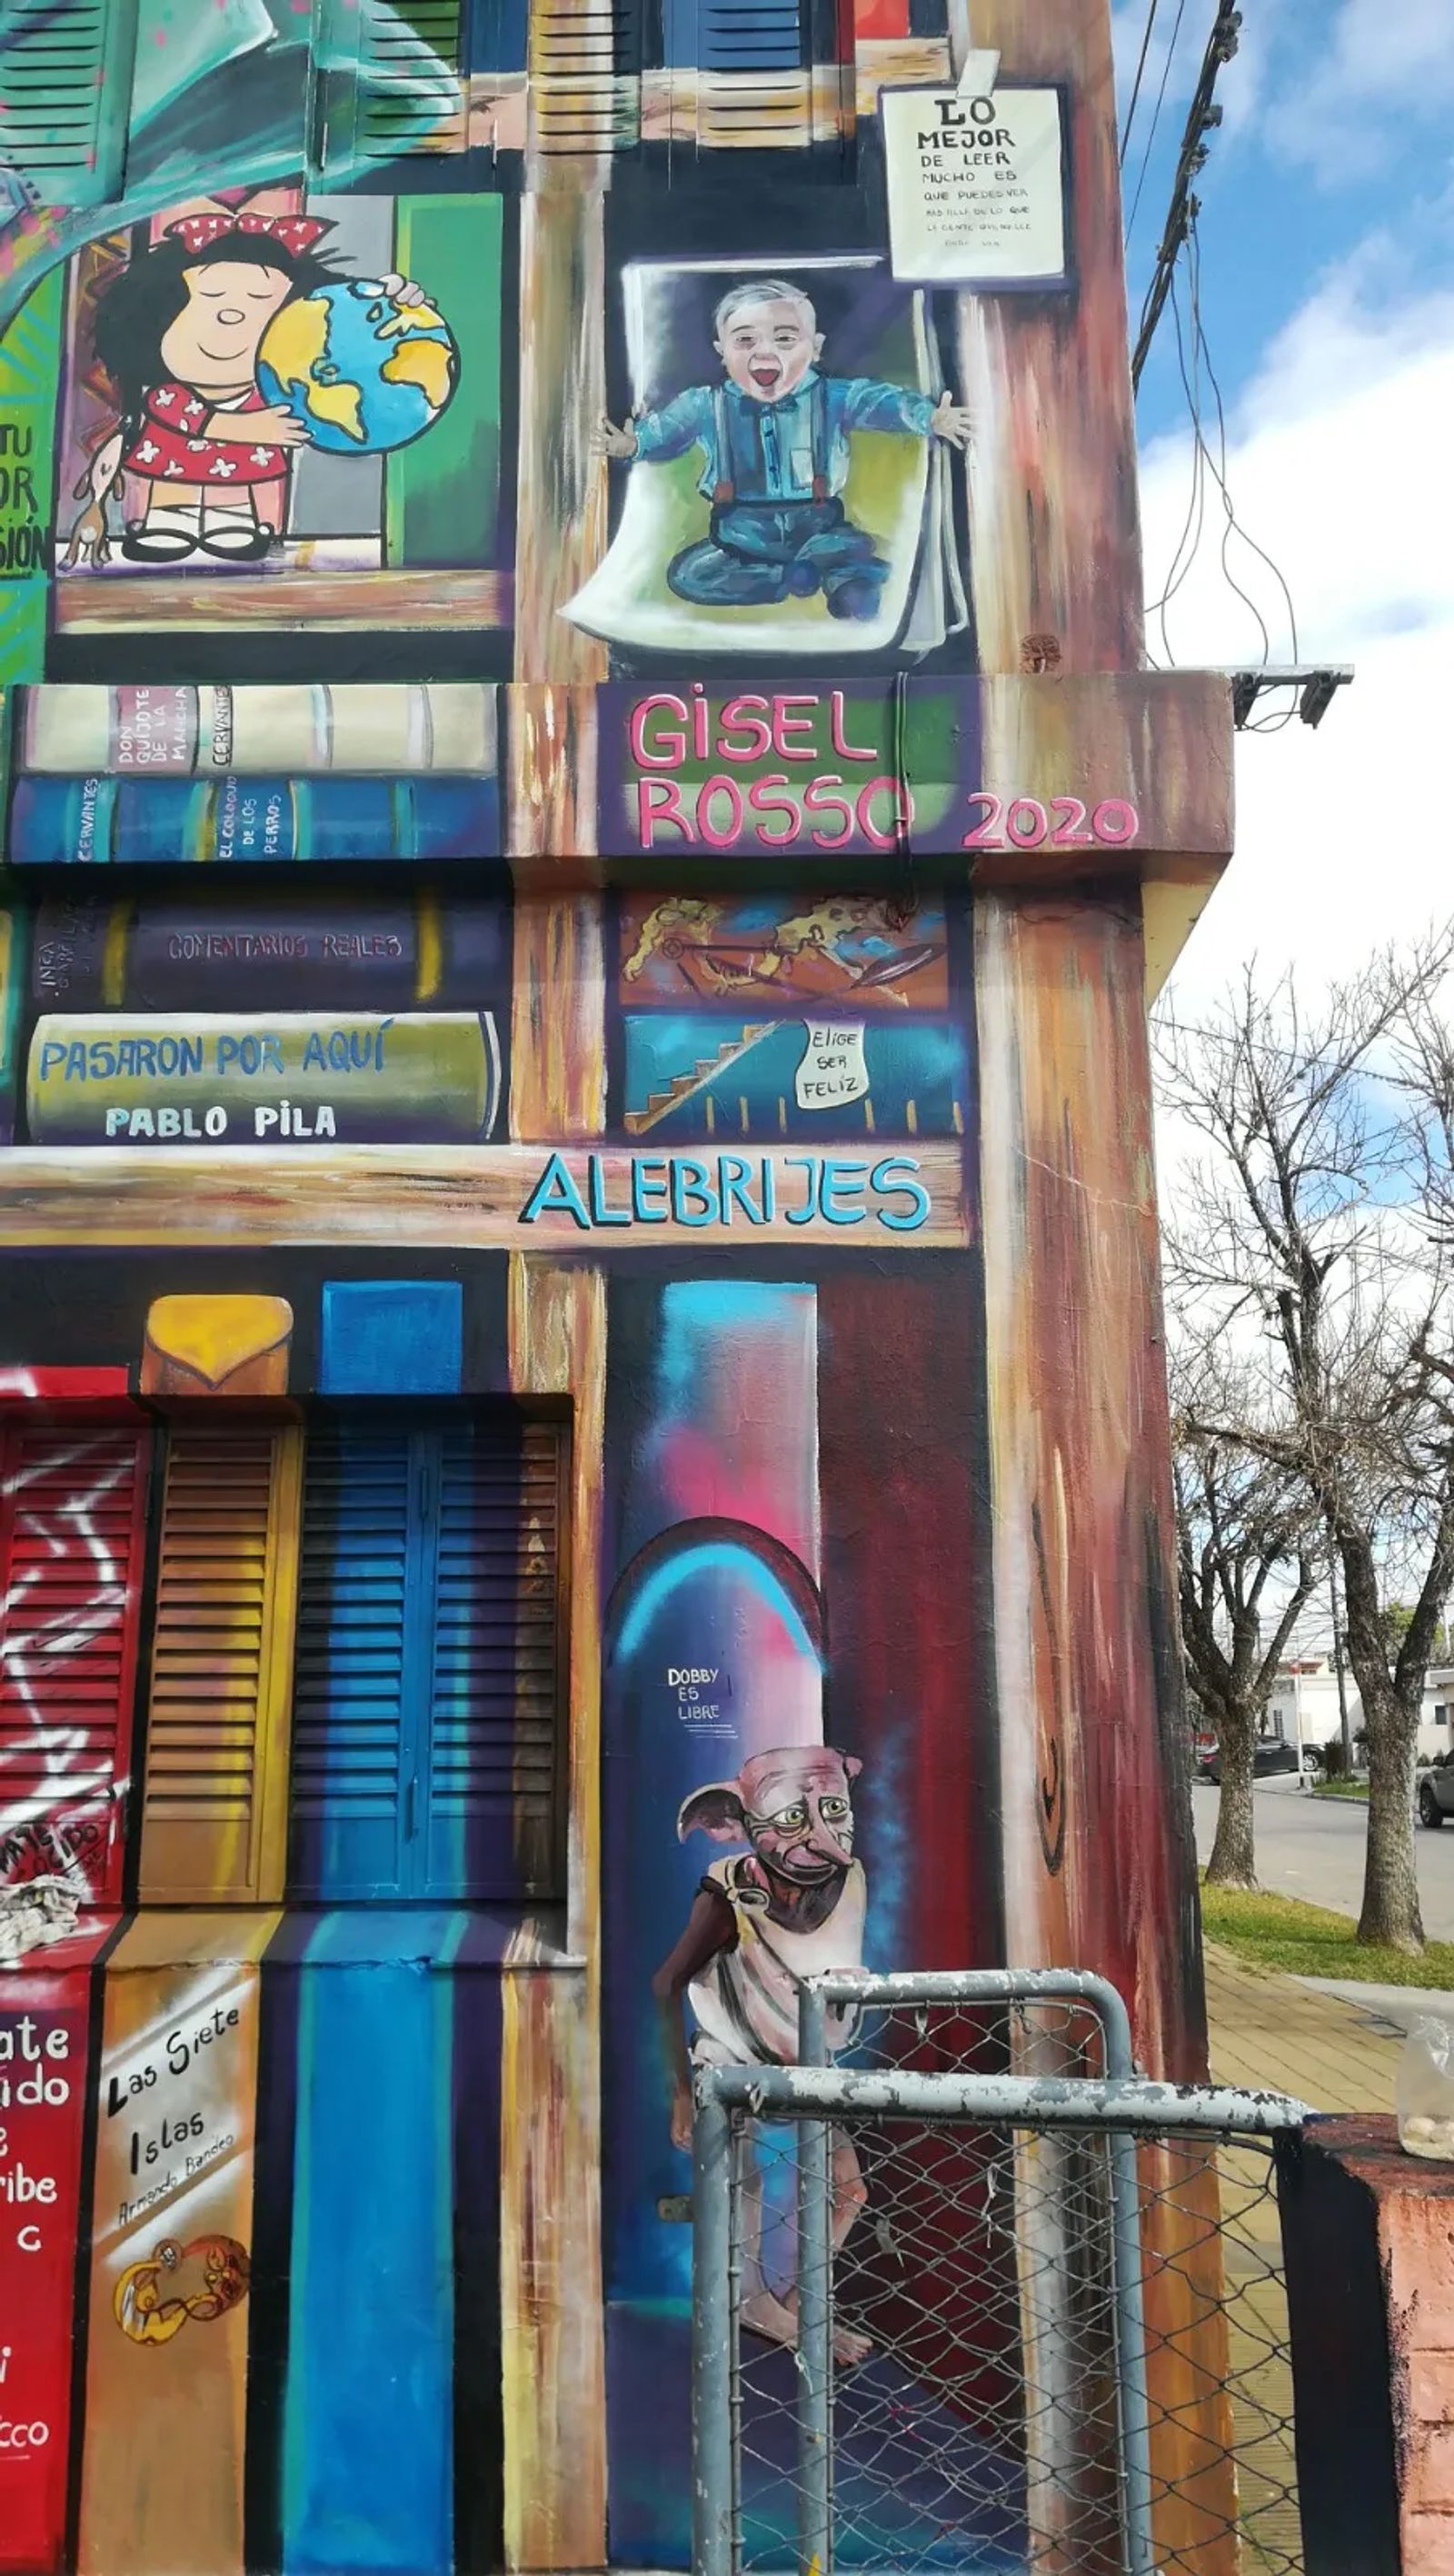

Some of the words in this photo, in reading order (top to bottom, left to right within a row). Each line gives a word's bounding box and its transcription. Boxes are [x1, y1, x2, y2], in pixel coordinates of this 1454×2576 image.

[934, 96, 996, 125] LO
[917, 129, 1016, 149] MEJOR
[921, 154, 943, 167] DE
[963, 152, 1011, 165] LEER
[922, 172, 976, 184] MUCHO
[994, 170, 1018, 181] ES
[923, 191, 951, 201] QUE
[135, 689, 152, 764] QUIJOTE
[152, 704, 166, 728] LA
[172, 686, 188, 761] MANCHA
[118, 726, 134, 763] DON
[151, 741, 167, 762] DE
[77, 778, 99, 862] CERVANTES
[242, 798, 258, 825] LOS
[264, 793, 282, 854] PERROS
[637, 774, 915, 849] ROSSO
[962, 791, 1140, 850] 2020
[219, 843, 234, 859] EL
[323, 933, 403, 960] REALES
[39, 1034, 204, 1081] PASARON
[216, 1034, 284, 1076] POR
[303, 1017, 395, 1074] AQUÍ
[816, 1055, 846, 1070] SER
[105, 1105, 227, 1138] PABLO
[519, 1154, 932, 1230] ALEBRIJES
[667, 1667, 720, 1686] DOBBY
[678, 1686, 700, 1702] ES
[677, 1705, 720, 1720] LIBRE
[107, 2064, 158, 2119] Las
[165, 2006, 240, 2075] Siete
[130, 2111, 205, 2176] Islas
[117, 2170, 179, 2226] Armando
